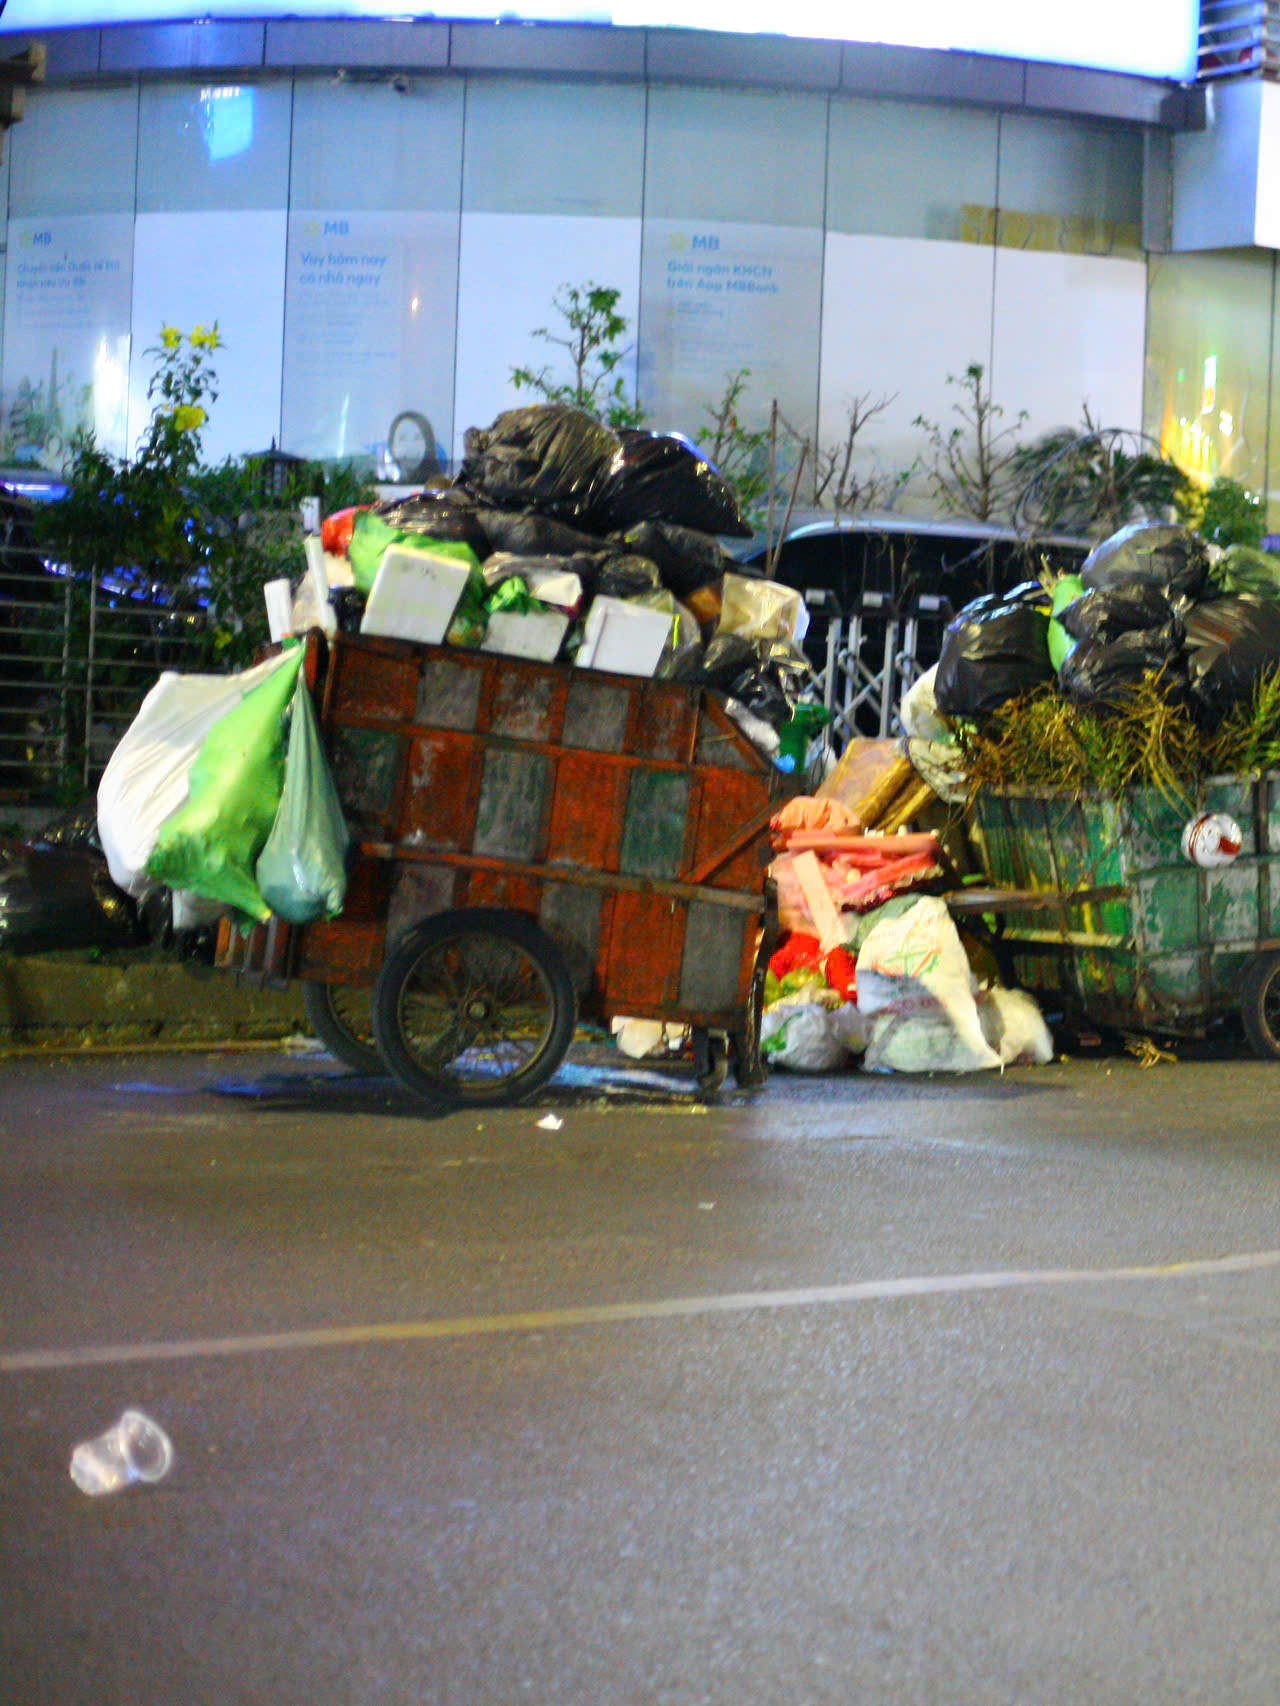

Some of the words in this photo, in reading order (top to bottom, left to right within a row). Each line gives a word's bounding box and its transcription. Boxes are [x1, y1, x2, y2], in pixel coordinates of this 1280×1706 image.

[323, 220, 350, 236] MB
[32, 231, 52, 245] MB
[691, 234, 720, 250] MB
